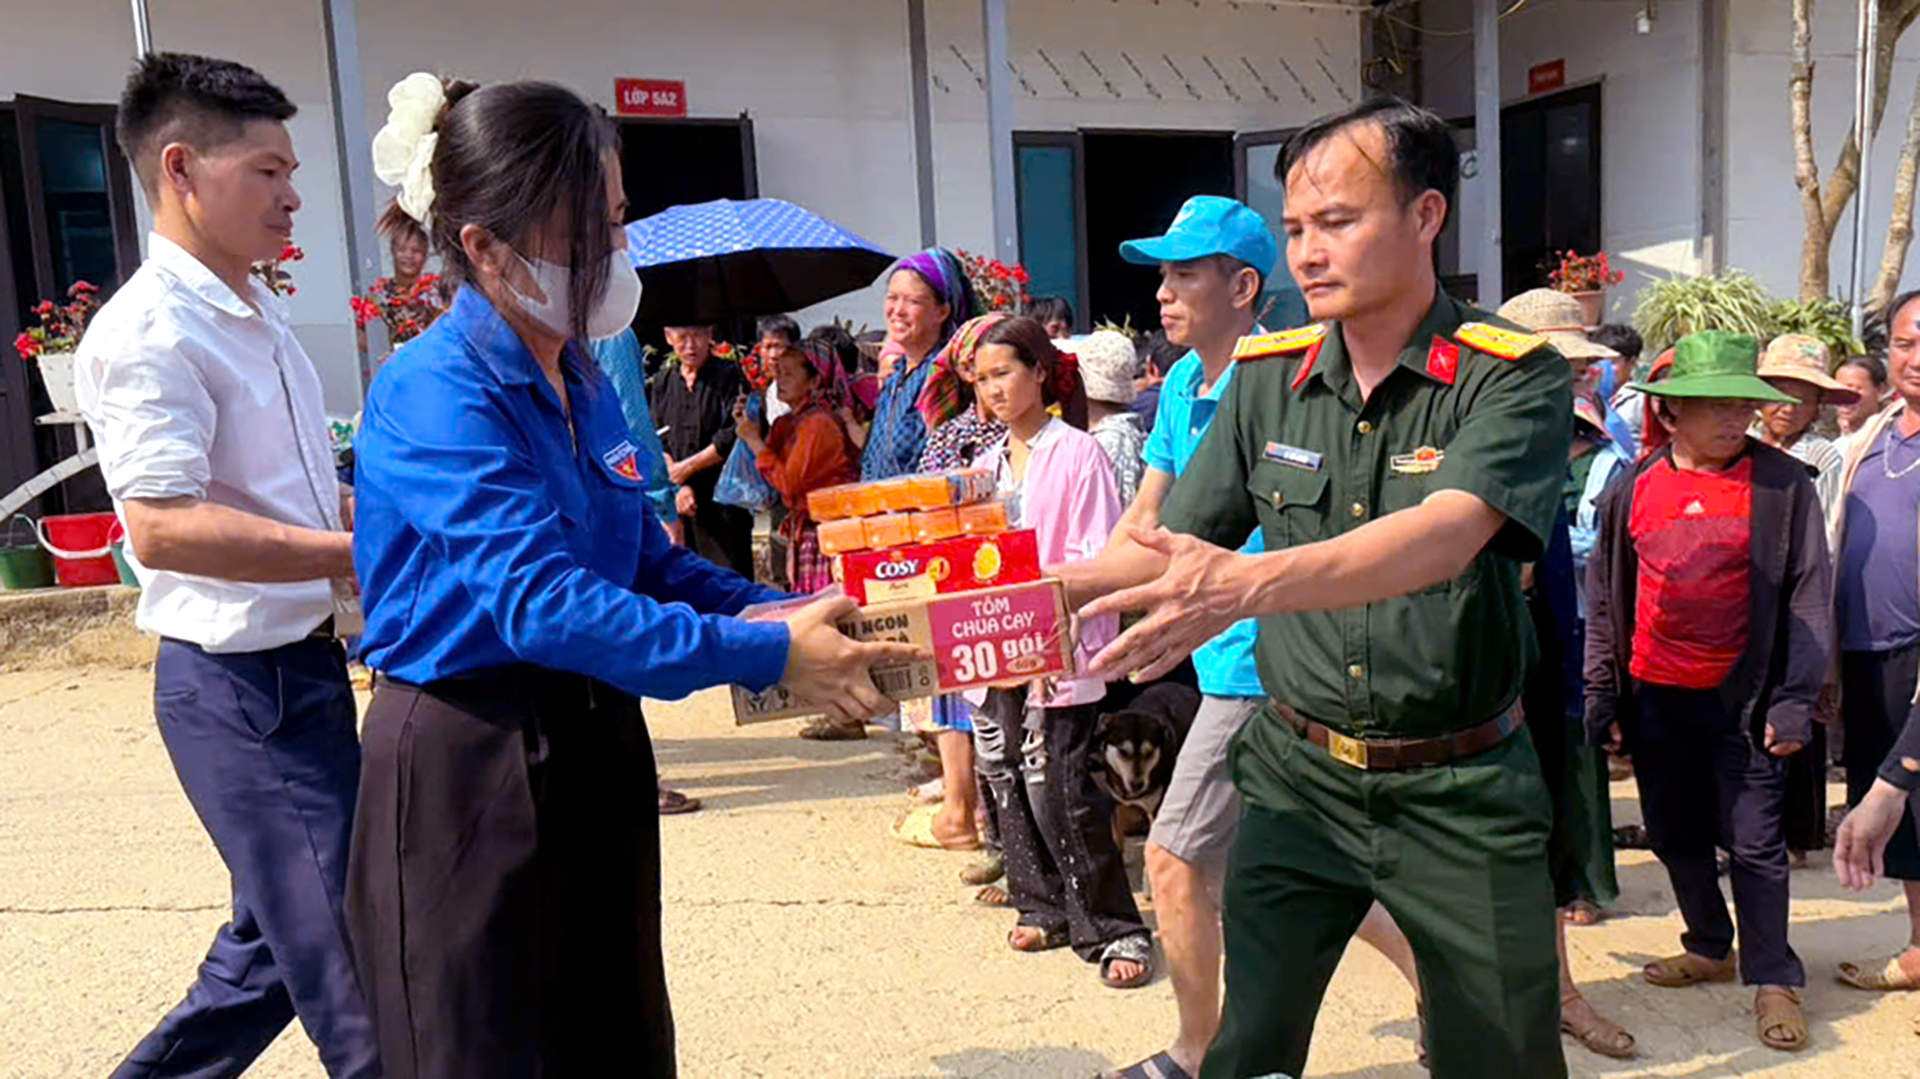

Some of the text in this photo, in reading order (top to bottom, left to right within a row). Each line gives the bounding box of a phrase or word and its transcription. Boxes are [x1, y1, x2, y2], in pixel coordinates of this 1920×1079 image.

[624, 86, 677, 107] LỚP 5A2
[876, 559, 919, 578] COSY
[971, 595, 1010, 617] TÔM
[862, 613, 909, 634] NGON
[952, 611, 1035, 639] CHUA CAY
[951, 632, 1043, 682] 30 gói
